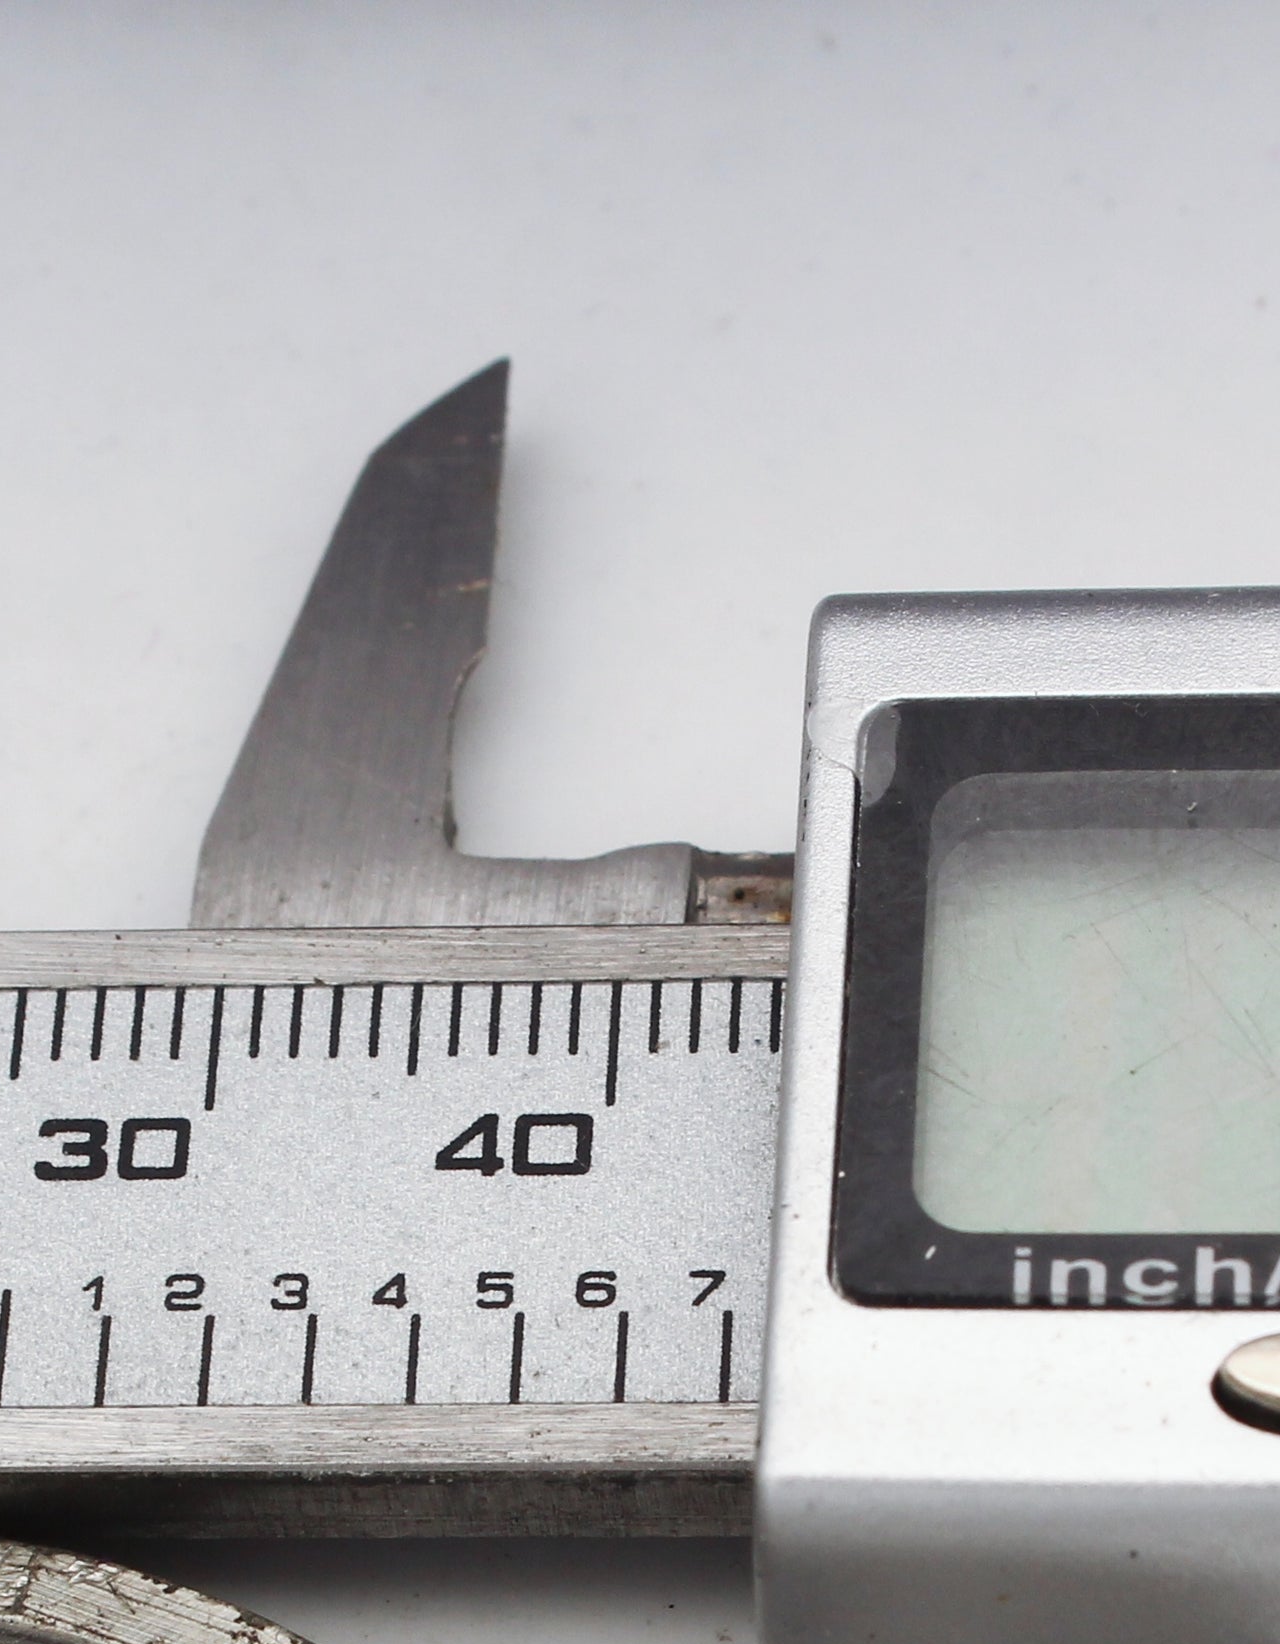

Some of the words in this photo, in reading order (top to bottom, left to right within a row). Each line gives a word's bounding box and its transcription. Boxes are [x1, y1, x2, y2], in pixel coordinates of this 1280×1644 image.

[33, 1117, 192, 1182] 30
[434, 1112, 594, 1178] 40
[82, 1275, 104, 1312] 1
[164, 1273, 206, 1312] 2
[270, 1272, 310, 1311] 3
[371, 1272, 409, 1310] 4
[475, 1271, 515, 1310] 5
[574, 1270, 618, 1309] 6
[688, 1269, 727, 1307] 7
